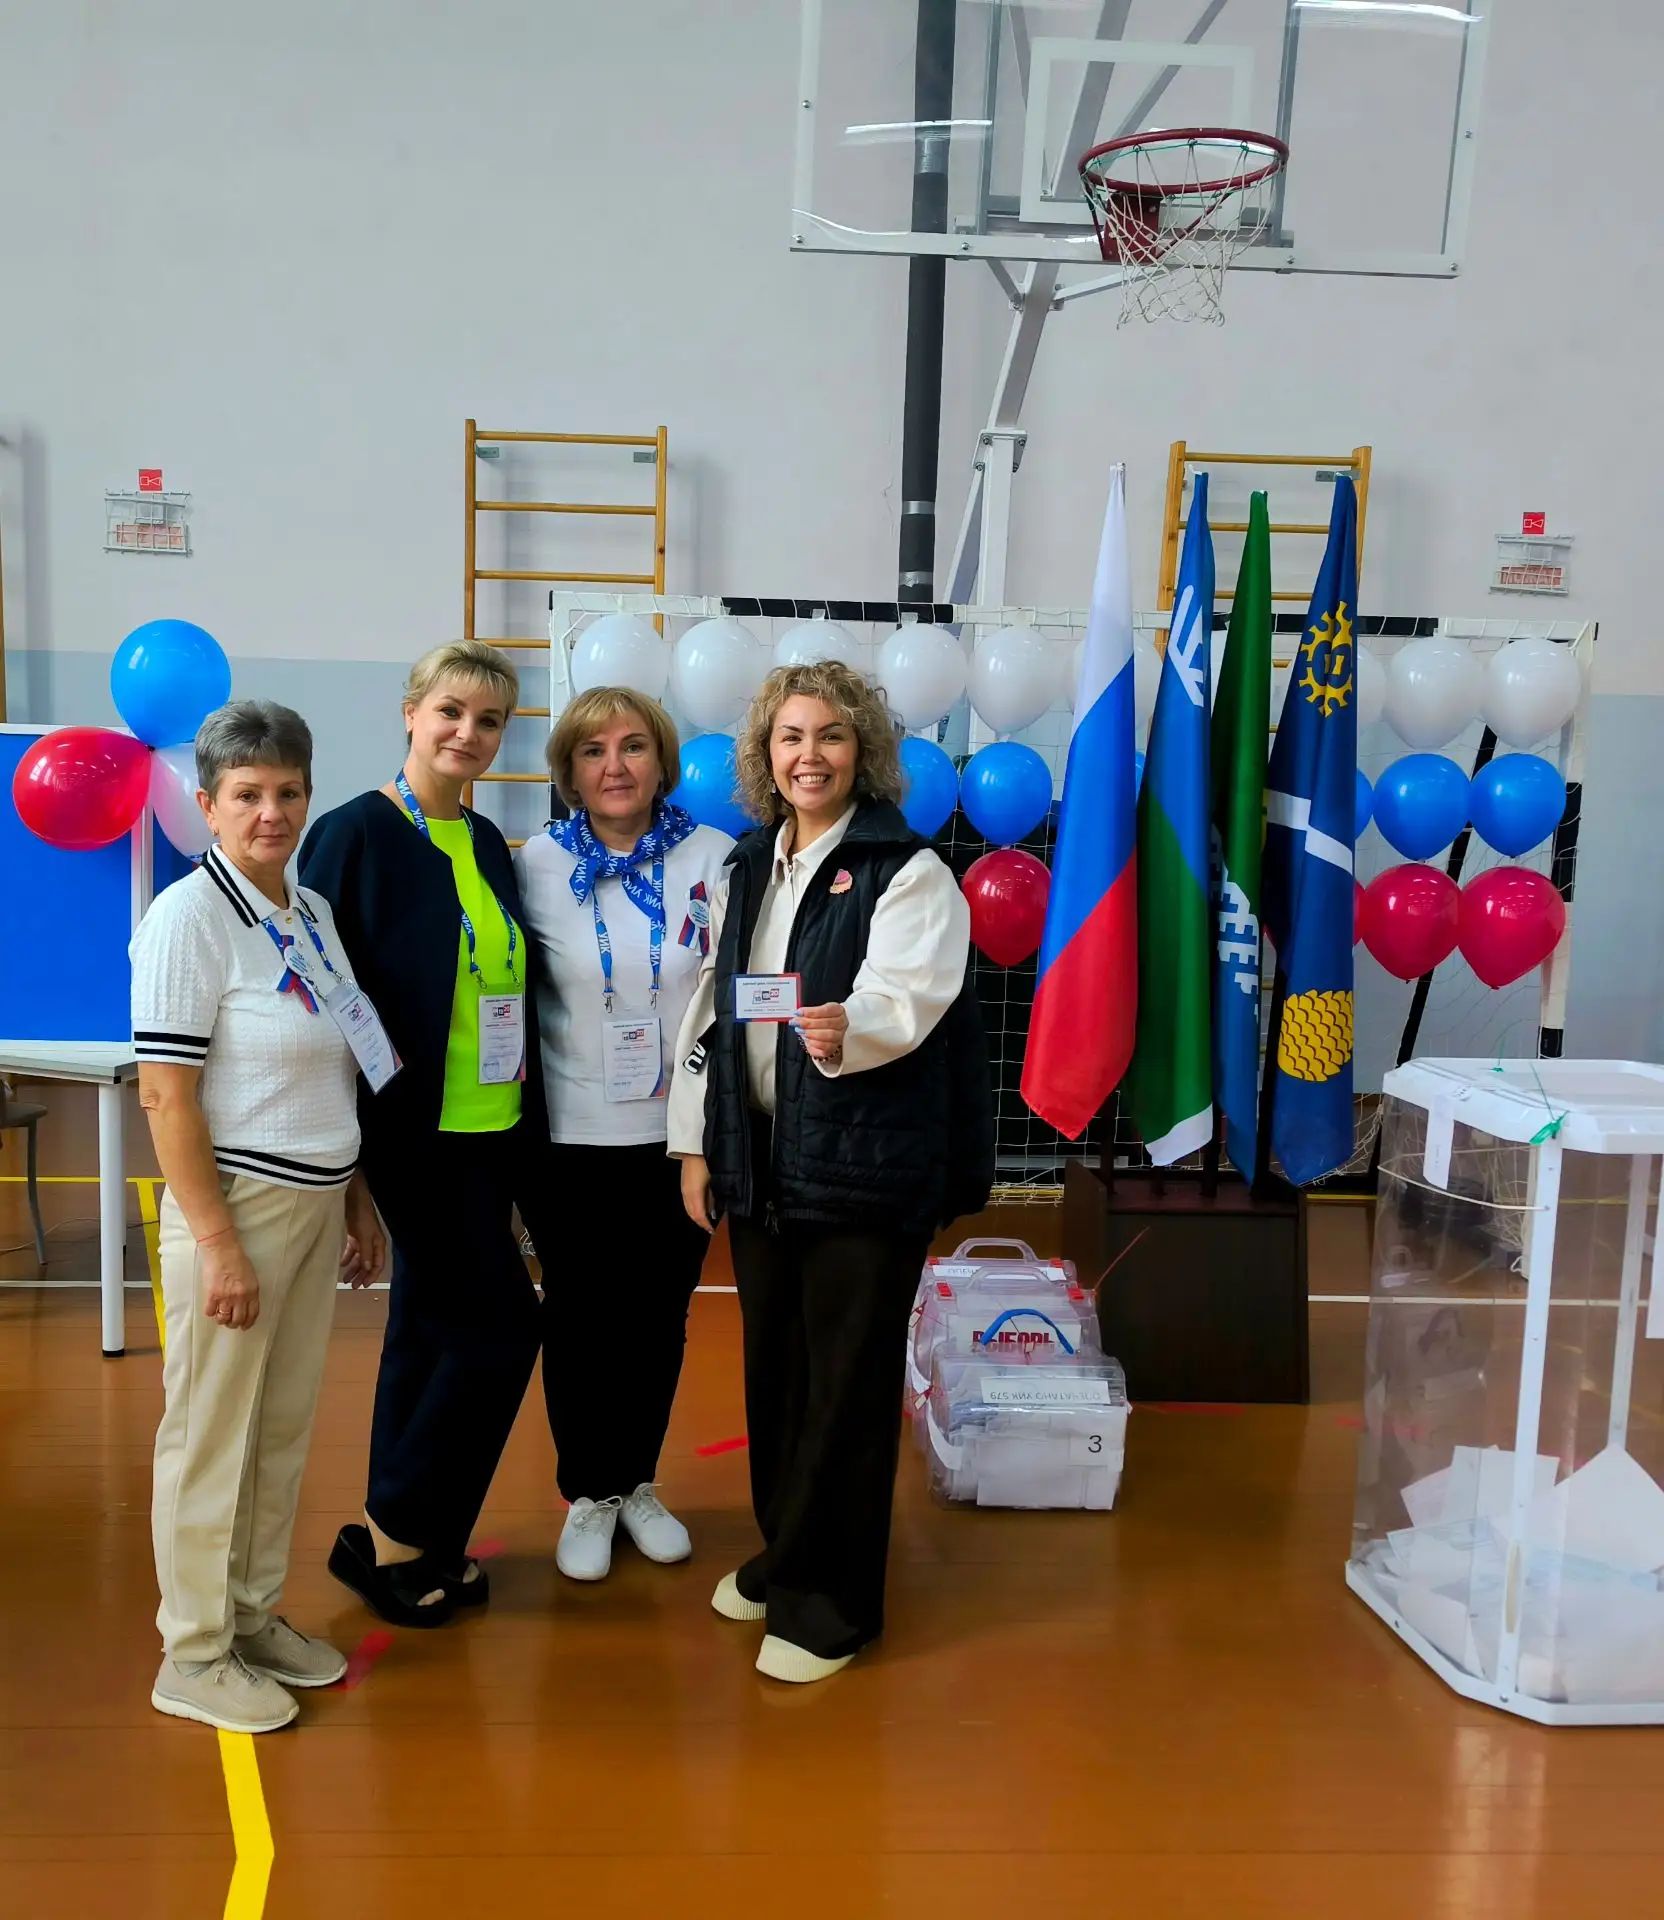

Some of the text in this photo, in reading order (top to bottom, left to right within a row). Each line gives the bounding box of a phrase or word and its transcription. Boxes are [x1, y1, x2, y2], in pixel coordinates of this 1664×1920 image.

[411, 807, 427, 830] УИК
[580, 823, 594, 848] УИК
[574, 858, 588, 884] УИК
[643, 892, 662, 910] УИК
[598, 931, 611, 955] УИК
[650, 943, 661, 967] УИК
[1087, 1434, 1103, 1454] 3
